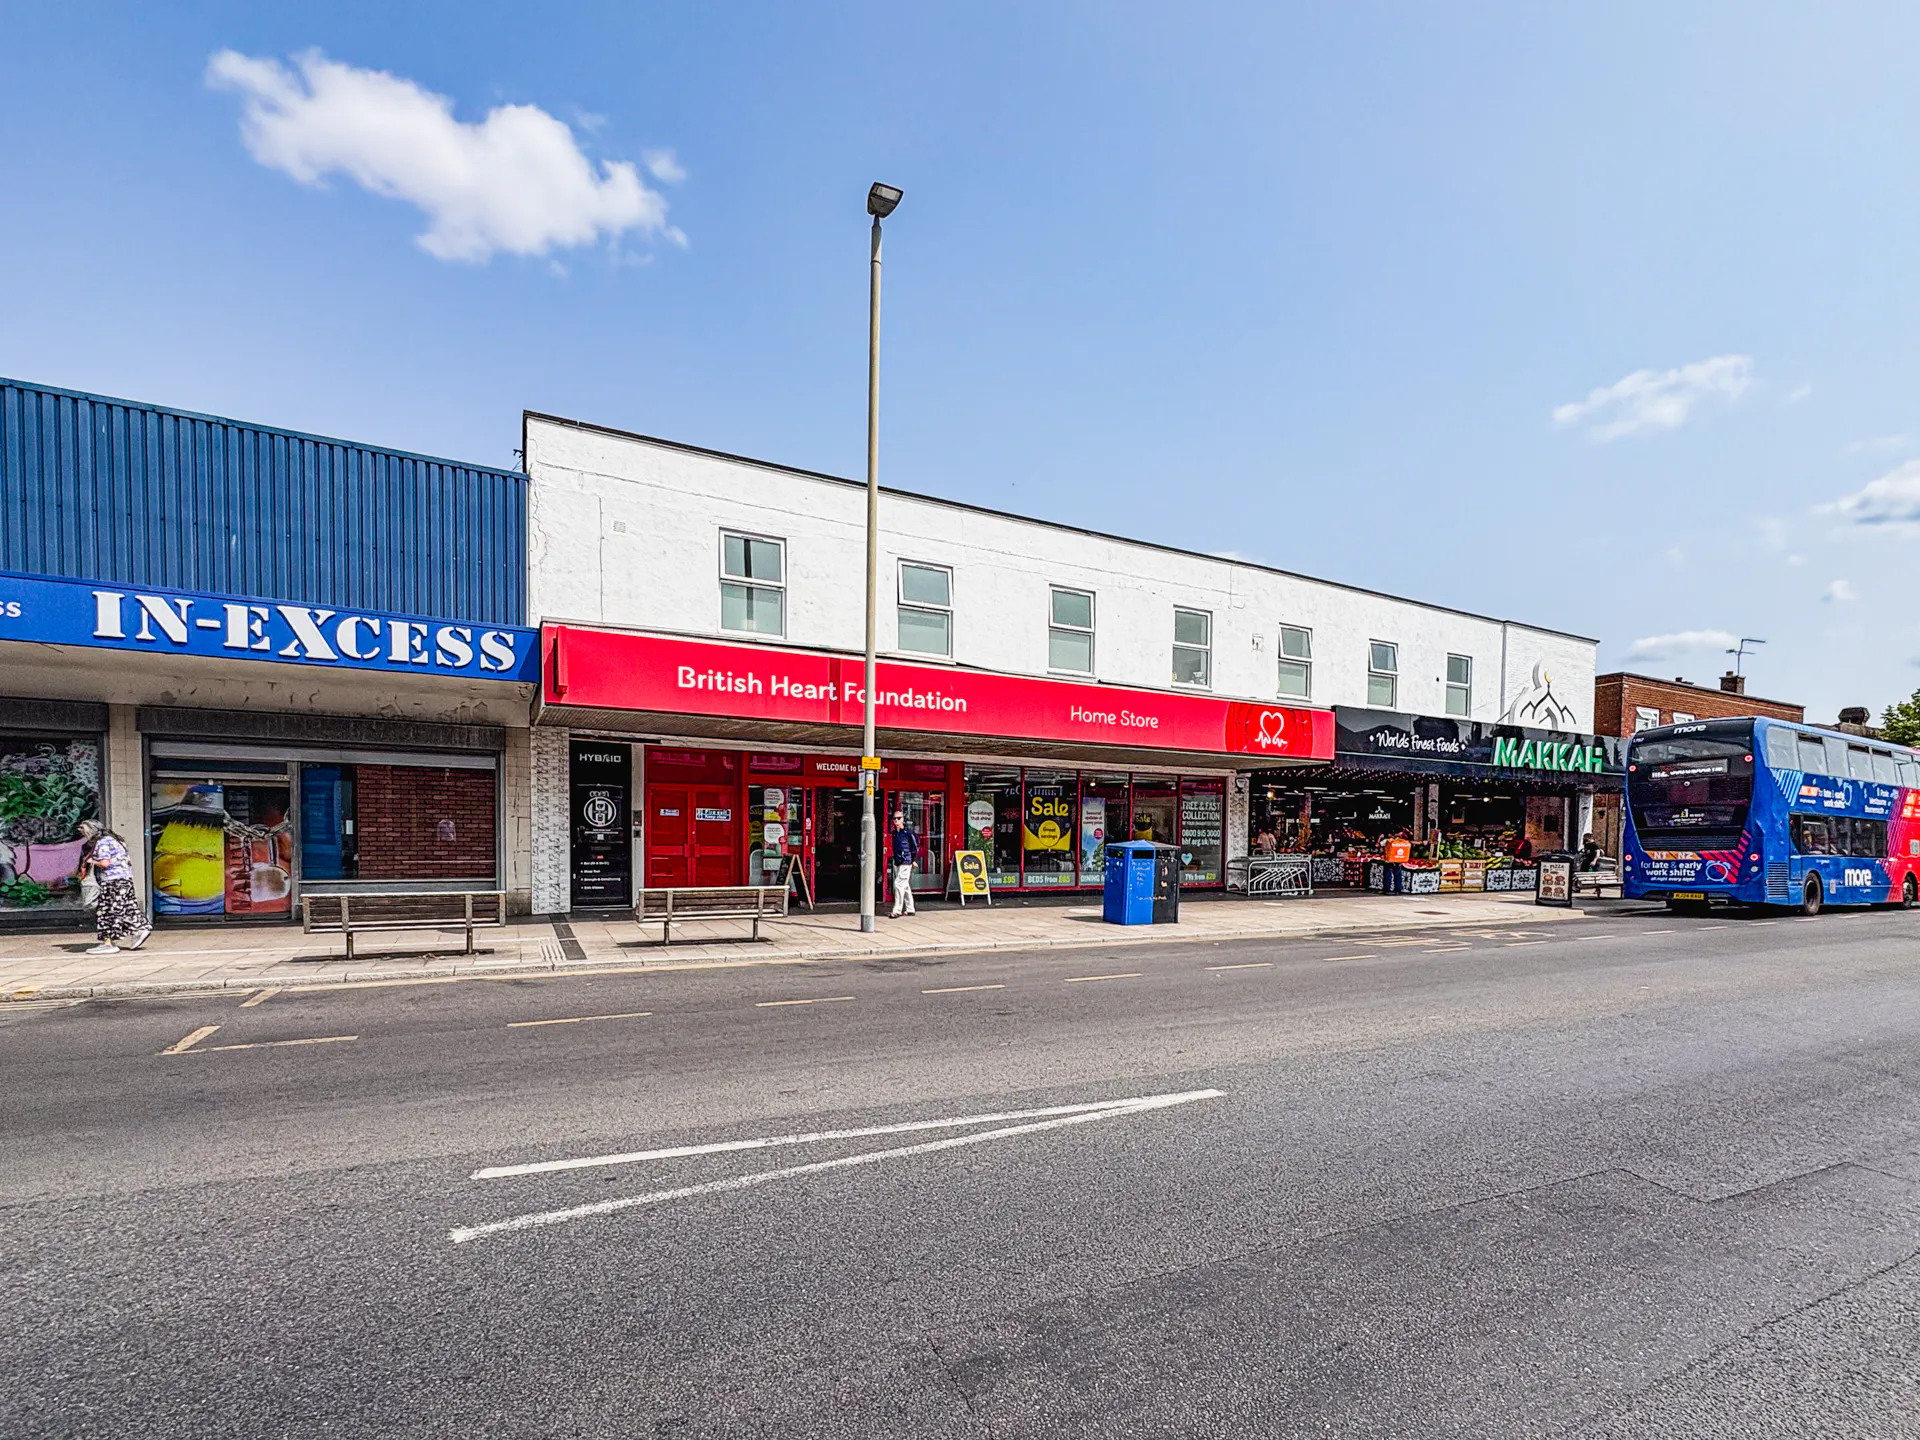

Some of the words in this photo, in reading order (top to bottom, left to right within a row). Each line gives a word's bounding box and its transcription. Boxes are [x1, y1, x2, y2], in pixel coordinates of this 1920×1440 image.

[92, 591, 516, 671] IN-EXCESS
[677, 665, 763, 695] British
[771, 675, 838, 701] Heart
[844, 682, 967, 712] Foundation
[1070, 705, 1117, 725] Home
[1120, 710, 1159, 729] Store
[1673, 724, 1707, 734] more
[1376, 730, 1410, 748] Worlds
[1411, 735, 1437, 751] Finest
[1436, 737, 1459, 753] Foods
[1493, 736, 1603, 774] MAKKAH
[816, 763, 849, 772] WELCOME
[1031, 796, 1069, 817] Sale
[1182, 801, 1198, 810] FREE
[1205, 802, 1220, 811] FAST
[1182, 811, 1220, 820] COLLECTION
[1653, 851, 1667, 860] N1
[1677, 851, 1693, 860] N2
[963, 861, 980, 870] Sale
[1640, 861, 1651, 869] for
[1652, 861, 1669, 869] late
[1670, 861, 1677, 869] &
[1679, 861, 1702, 871] early
[1646, 868, 1668, 876] work
[1669, 868, 1695, 877] shifts
[1844, 868, 1872, 887] more
